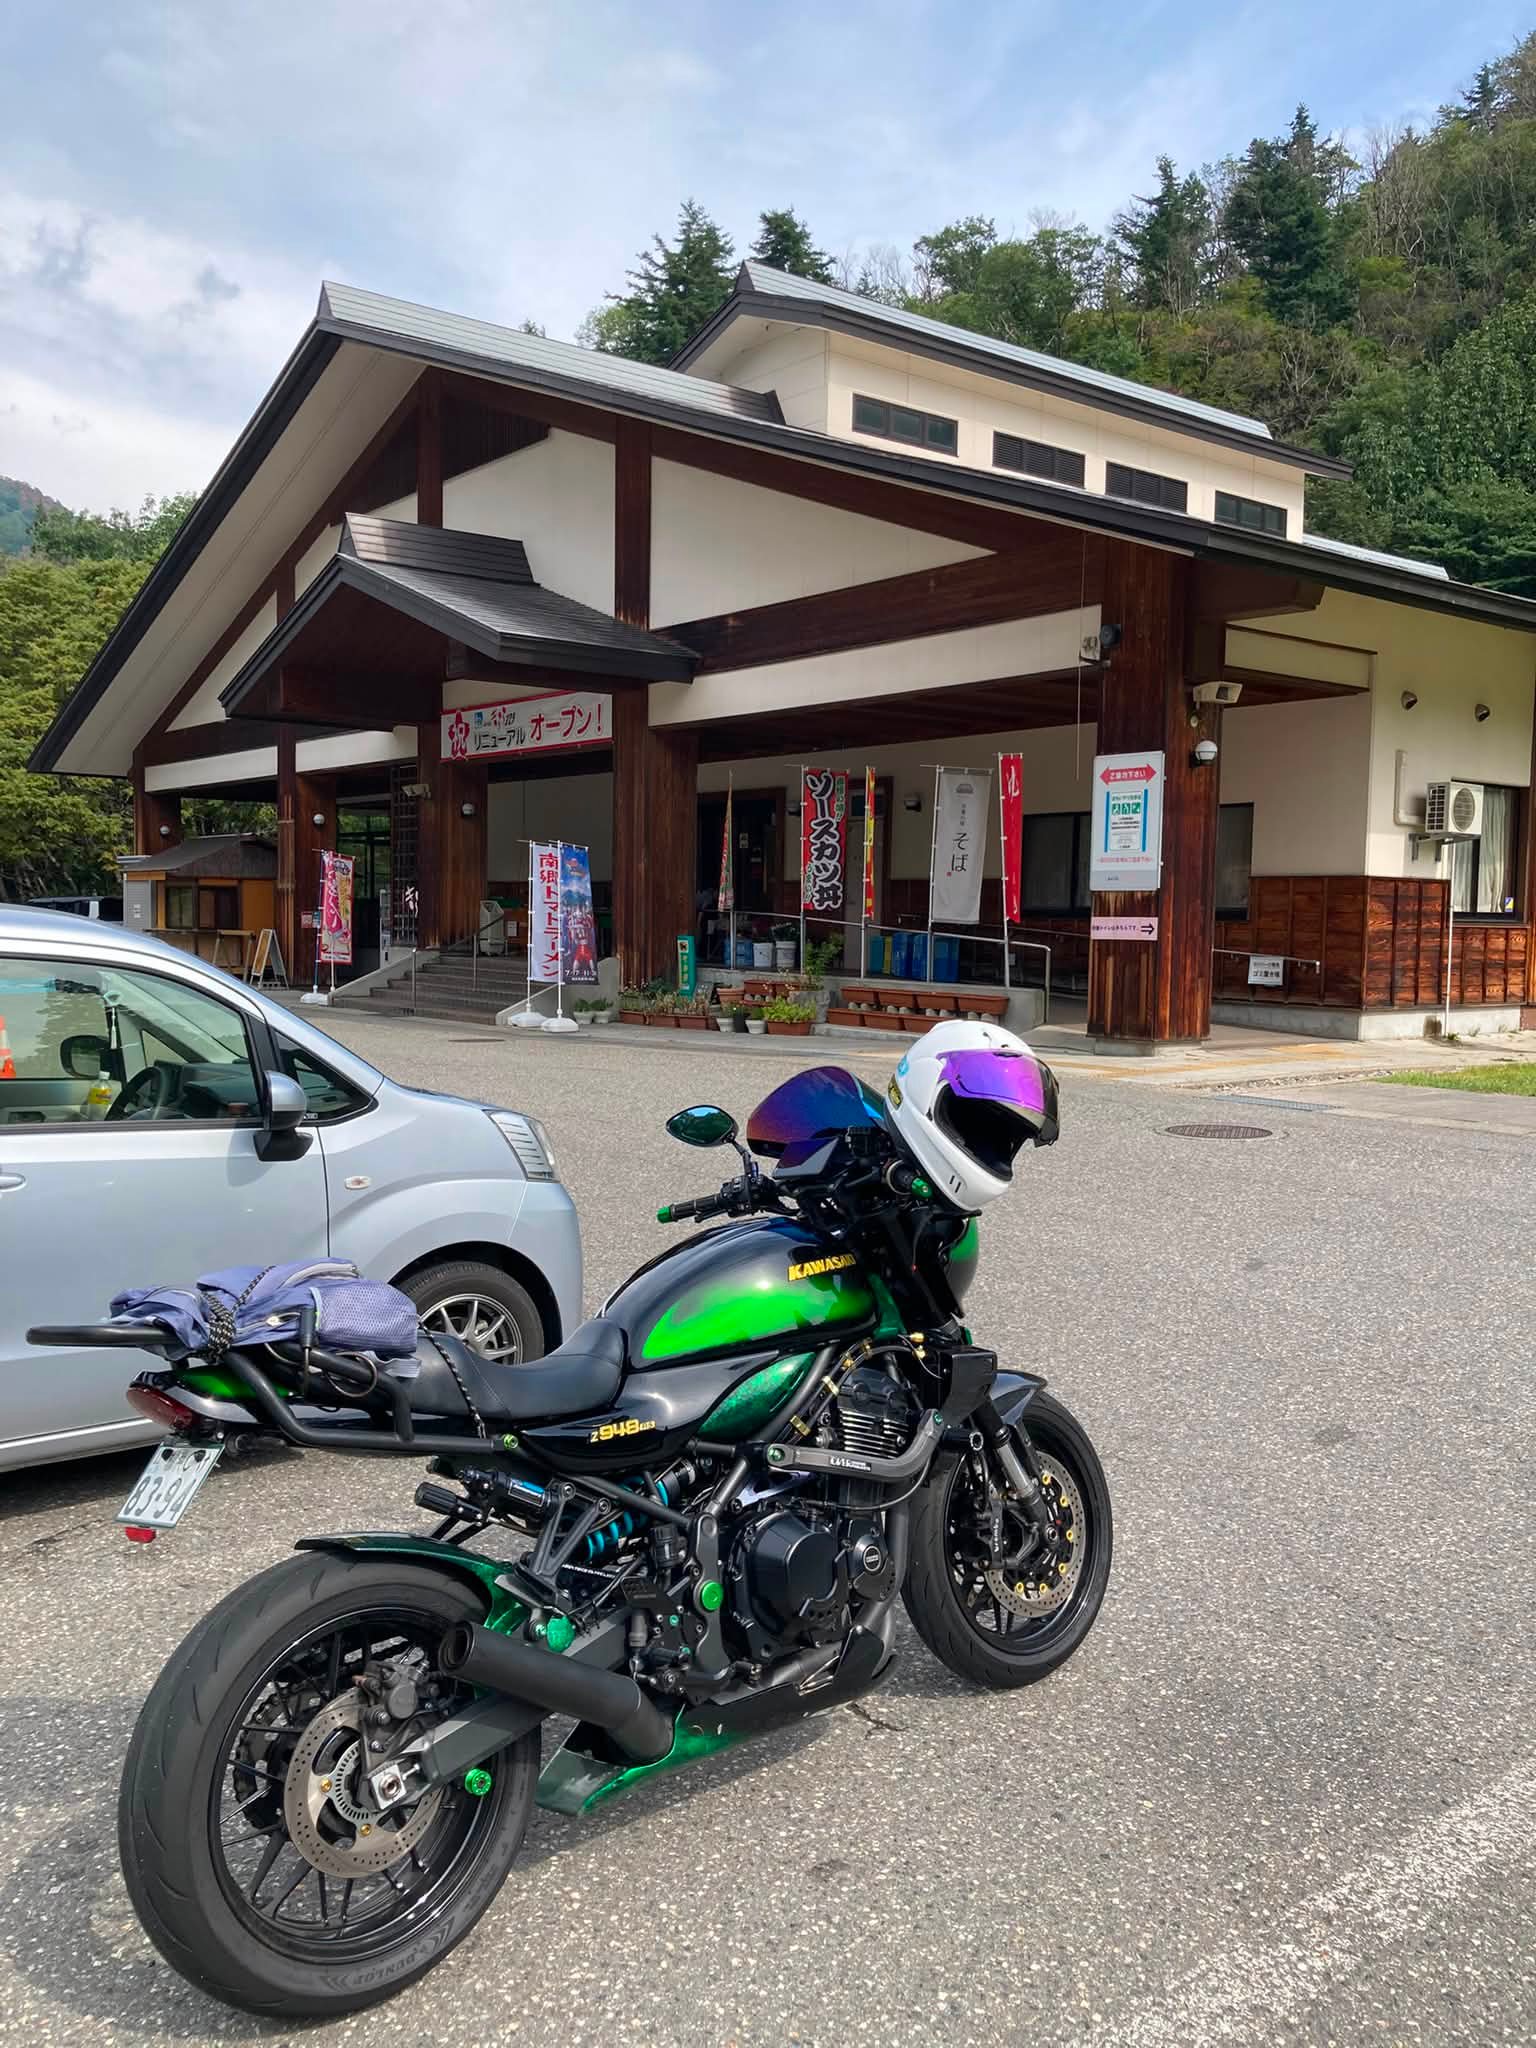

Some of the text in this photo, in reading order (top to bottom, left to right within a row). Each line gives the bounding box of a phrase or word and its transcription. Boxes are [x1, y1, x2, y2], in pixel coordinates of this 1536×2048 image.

[474, 728, 526, 751] リニューアル
[806, 772, 843, 910] ソースカツ丼
[951, 832, 970, 873] そば
[539, 852, 560, 978] 南郷トマトラーメン
[788, 1253, 857, 1282] KAWASAKI
[123, 1475, 197, 1521] 83-94
[353, 1952, 416, 1985] DUNLOP
